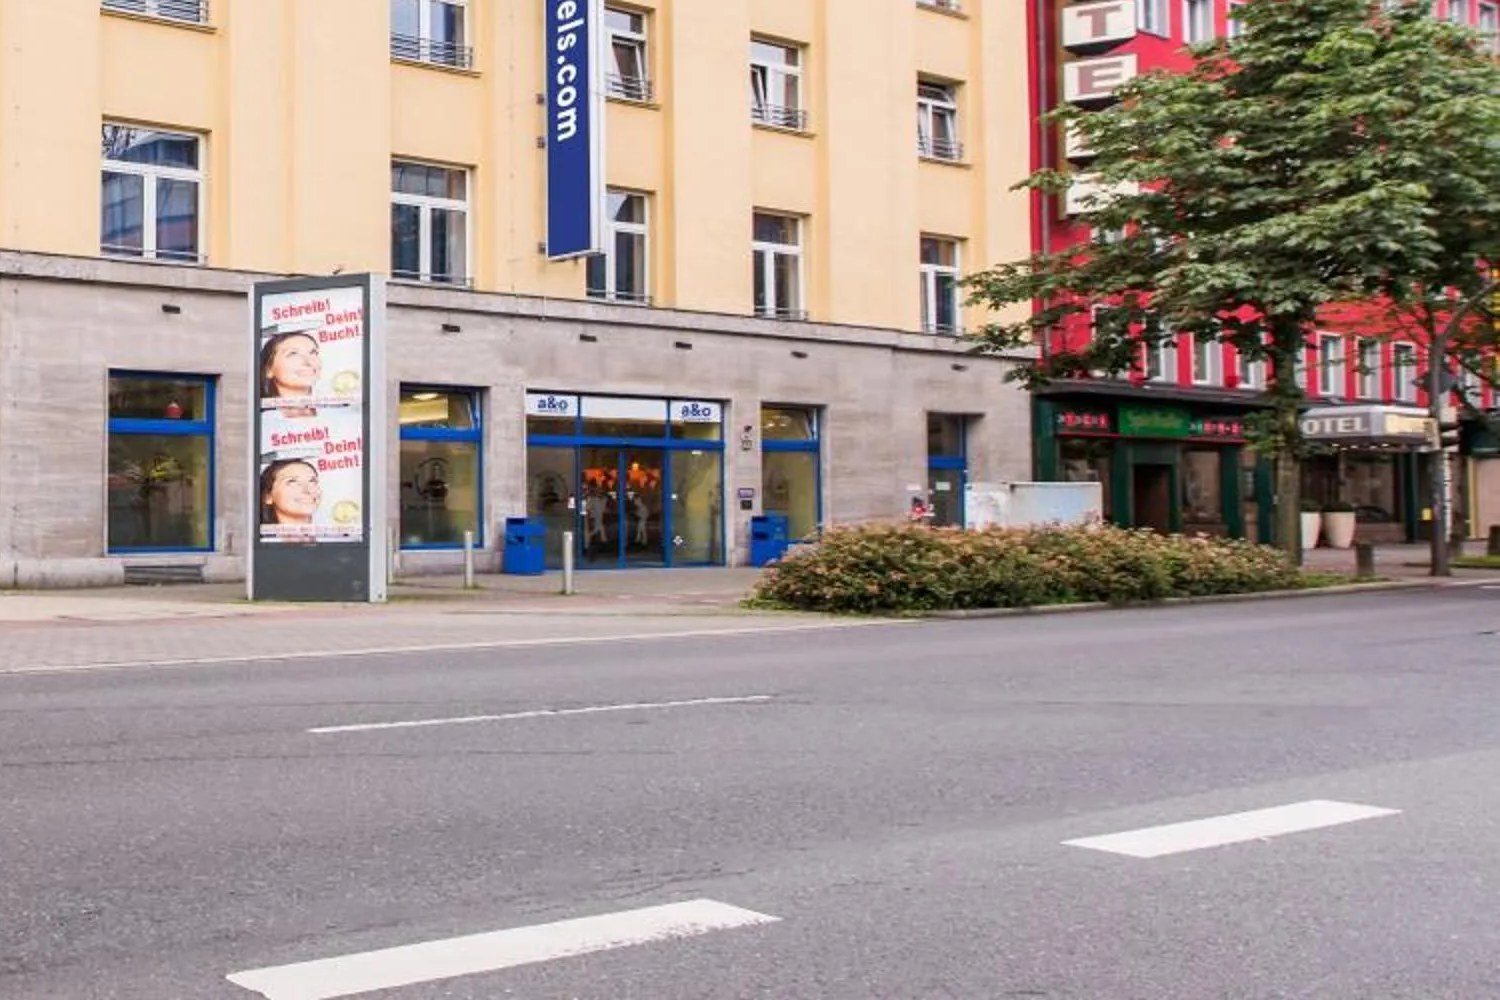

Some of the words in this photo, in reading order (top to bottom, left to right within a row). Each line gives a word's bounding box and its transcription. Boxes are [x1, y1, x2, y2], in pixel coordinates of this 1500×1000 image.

[272, 298, 331, 320] Schreib!
[325, 307, 363, 325] Dein!
[318, 325, 360, 342] Buch!
[537, 395, 569, 411] a&o
[681, 403, 712, 418] a&o
[1301, 416, 1368, 435] OTEL
[271, 426, 330, 447] Schreib!
[324, 436, 363, 454] Dein!
[317, 455, 360, 472] Buch!
